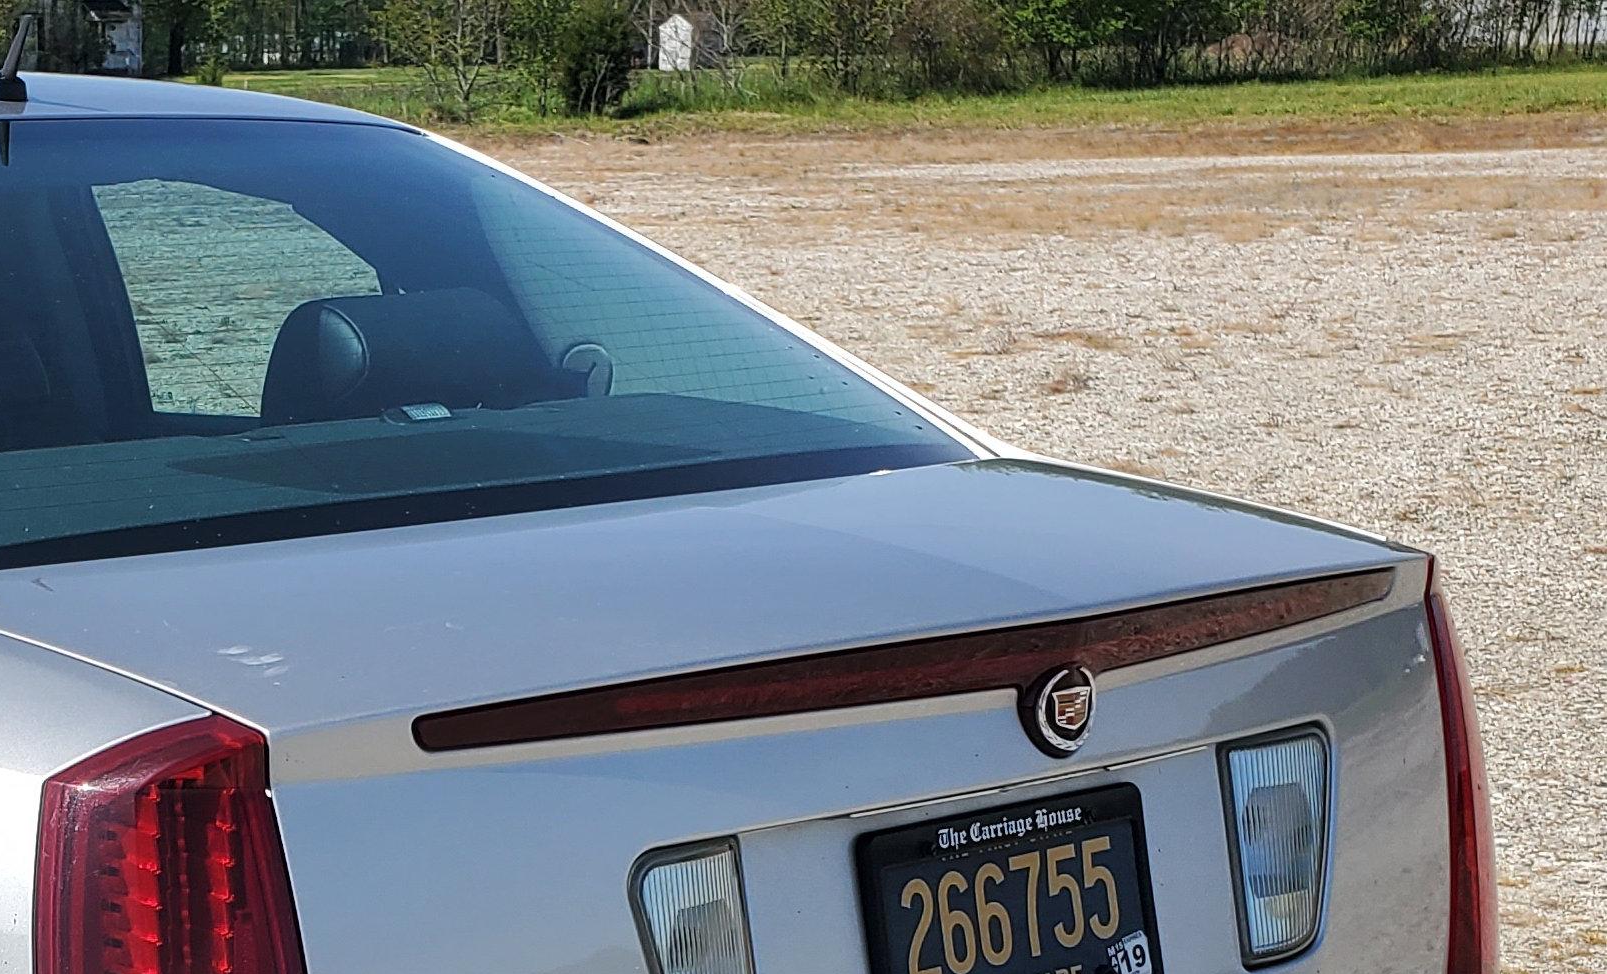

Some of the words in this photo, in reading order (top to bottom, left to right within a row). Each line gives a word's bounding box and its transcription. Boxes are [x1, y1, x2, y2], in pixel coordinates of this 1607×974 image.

[938, 828, 967, 850] The
[970, 817, 1033, 843] Carriage
[1035, 807, 1082, 832] House
[1121, 944, 1146, 973] 19
